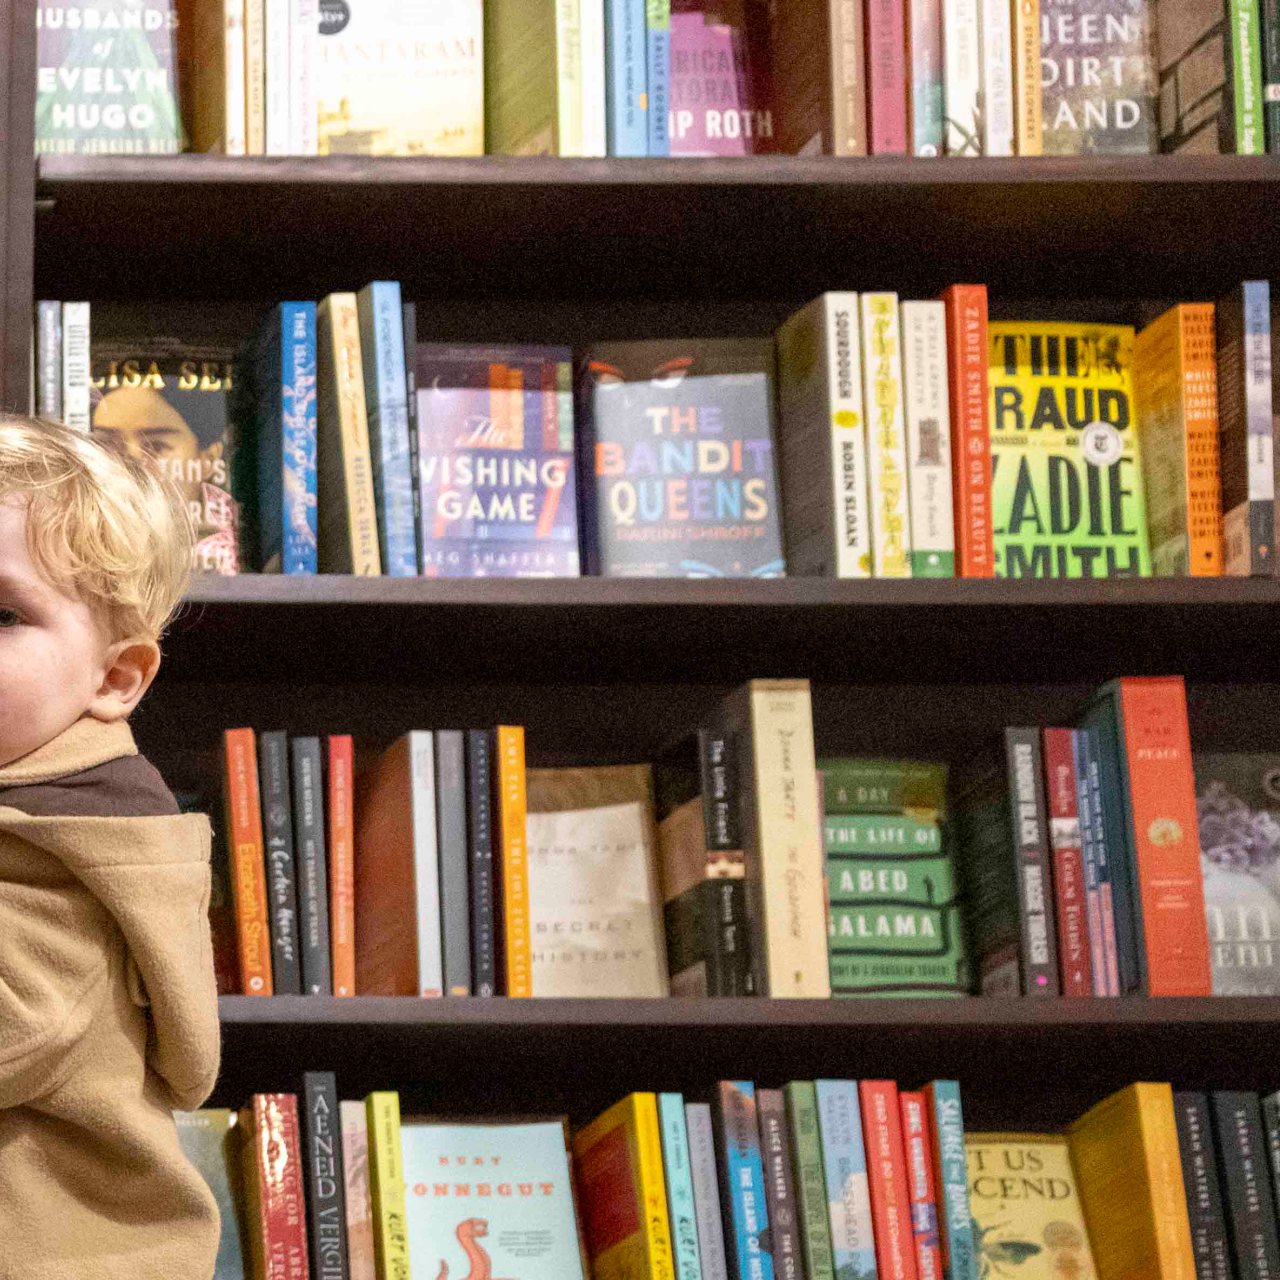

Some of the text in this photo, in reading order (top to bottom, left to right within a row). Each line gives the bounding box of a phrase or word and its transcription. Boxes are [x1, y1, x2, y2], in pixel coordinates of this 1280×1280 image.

[38, 66, 168, 94] EVELYN
[52, 104, 154, 128] HUGO
[645, 406, 725, 434] THE
[964, 306, 987, 566] ZADIE SMITH ON BEAUTY
[594, 439, 773, 477] BANDIT
[842, 440, 856, 492] ROBIN
[438, 492, 537, 522] GAME
[608, 479, 770, 527] QUEENS
[844, 494, 858, 549] SLOAN
[841, 869, 909, 892] ABED
[1003, 1152, 1044, 1172] US
[387, 1211, 405, 1252] KURT
